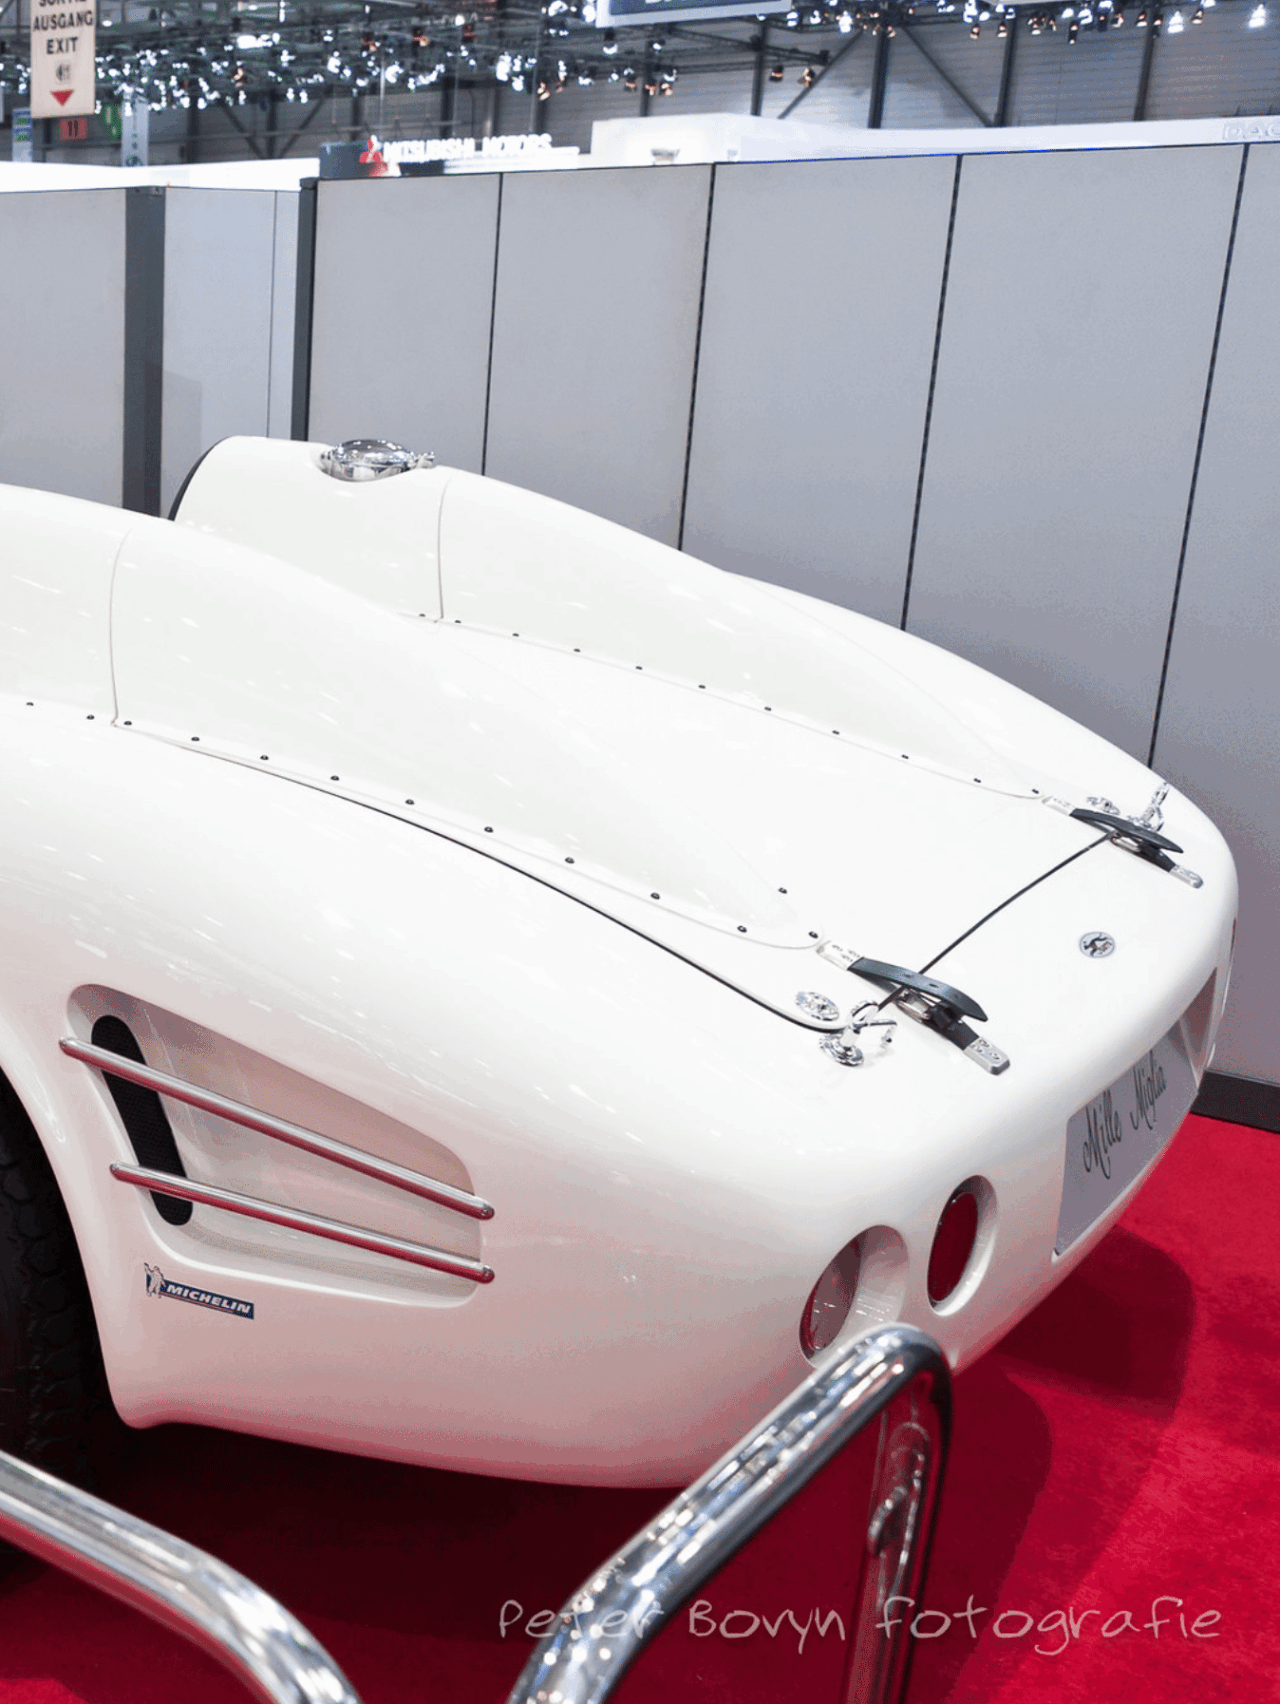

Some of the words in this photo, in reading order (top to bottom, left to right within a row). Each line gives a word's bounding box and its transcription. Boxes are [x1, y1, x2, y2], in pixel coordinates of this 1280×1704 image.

[32, 10, 93, 31] AUSGANG
[46, 37, 78, 54] EXIT
[383, 137, 475, 163] MITSUBISHI
[481, 132, 553, 156] MOTORS
[166, 1284, 251, 1314] MICHELIN
